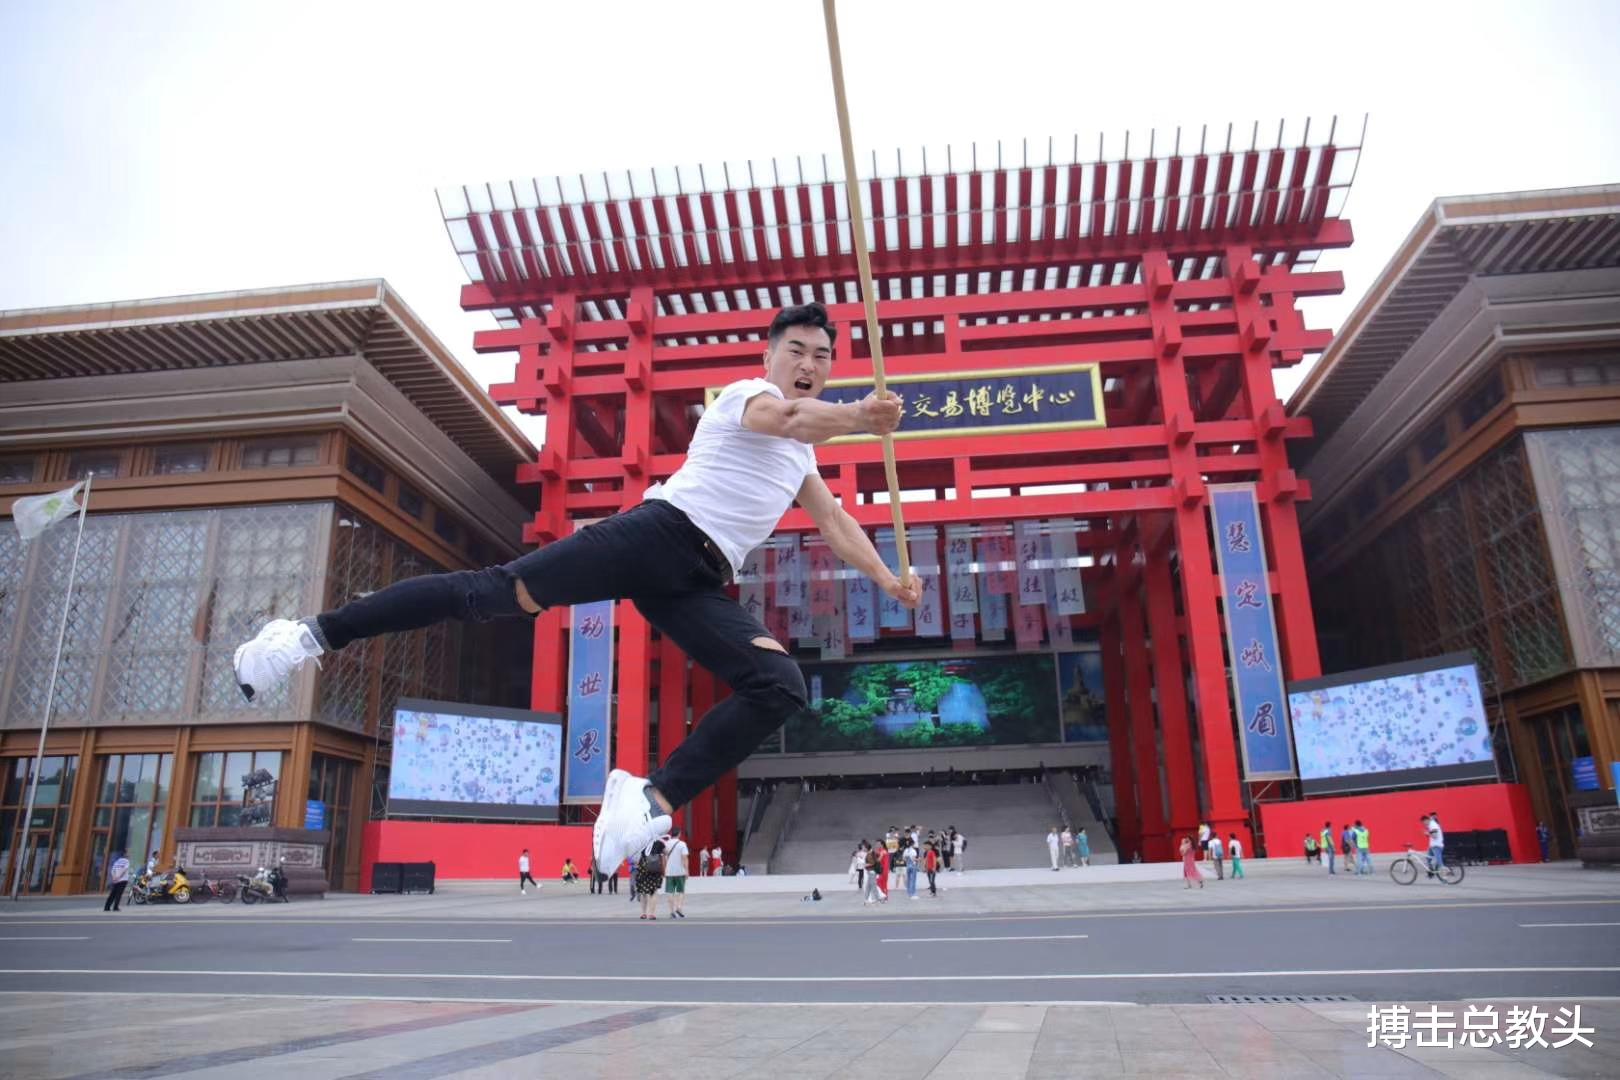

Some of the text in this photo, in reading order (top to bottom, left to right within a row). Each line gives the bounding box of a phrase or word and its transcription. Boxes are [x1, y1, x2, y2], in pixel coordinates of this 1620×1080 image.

[899, 382, 1077, 418] 交易博览中心
